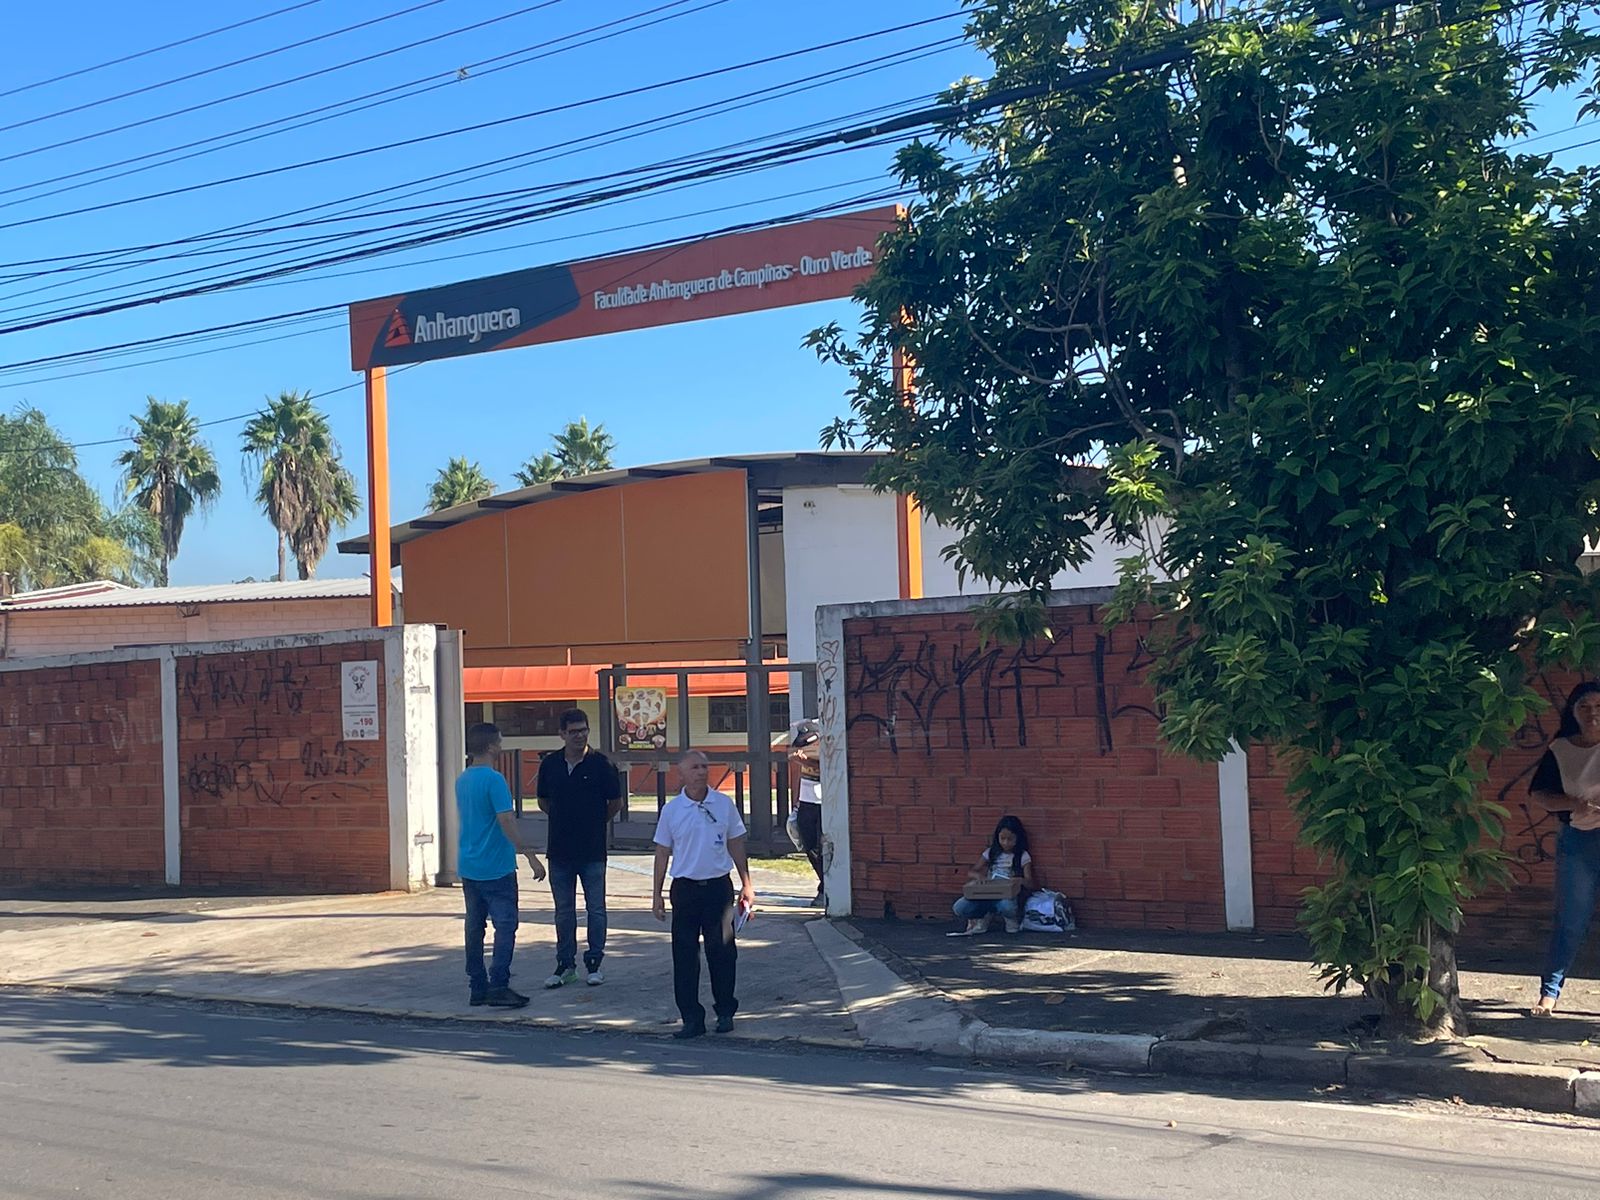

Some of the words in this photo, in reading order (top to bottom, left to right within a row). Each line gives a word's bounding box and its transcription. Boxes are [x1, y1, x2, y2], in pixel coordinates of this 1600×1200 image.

[594, 284, 648, 310] Faculdade
[648, 279, 716, 301] Anhanguera
[718, 269, 734, 290] de
[734, 264, 791, 288] Campinas
[800, 255, 830, 276] Ouro
[830, 246, 873, 271] Verde
[413, 307, 521, 344] Anhanguera
[360, 717, 373, 726] 190
